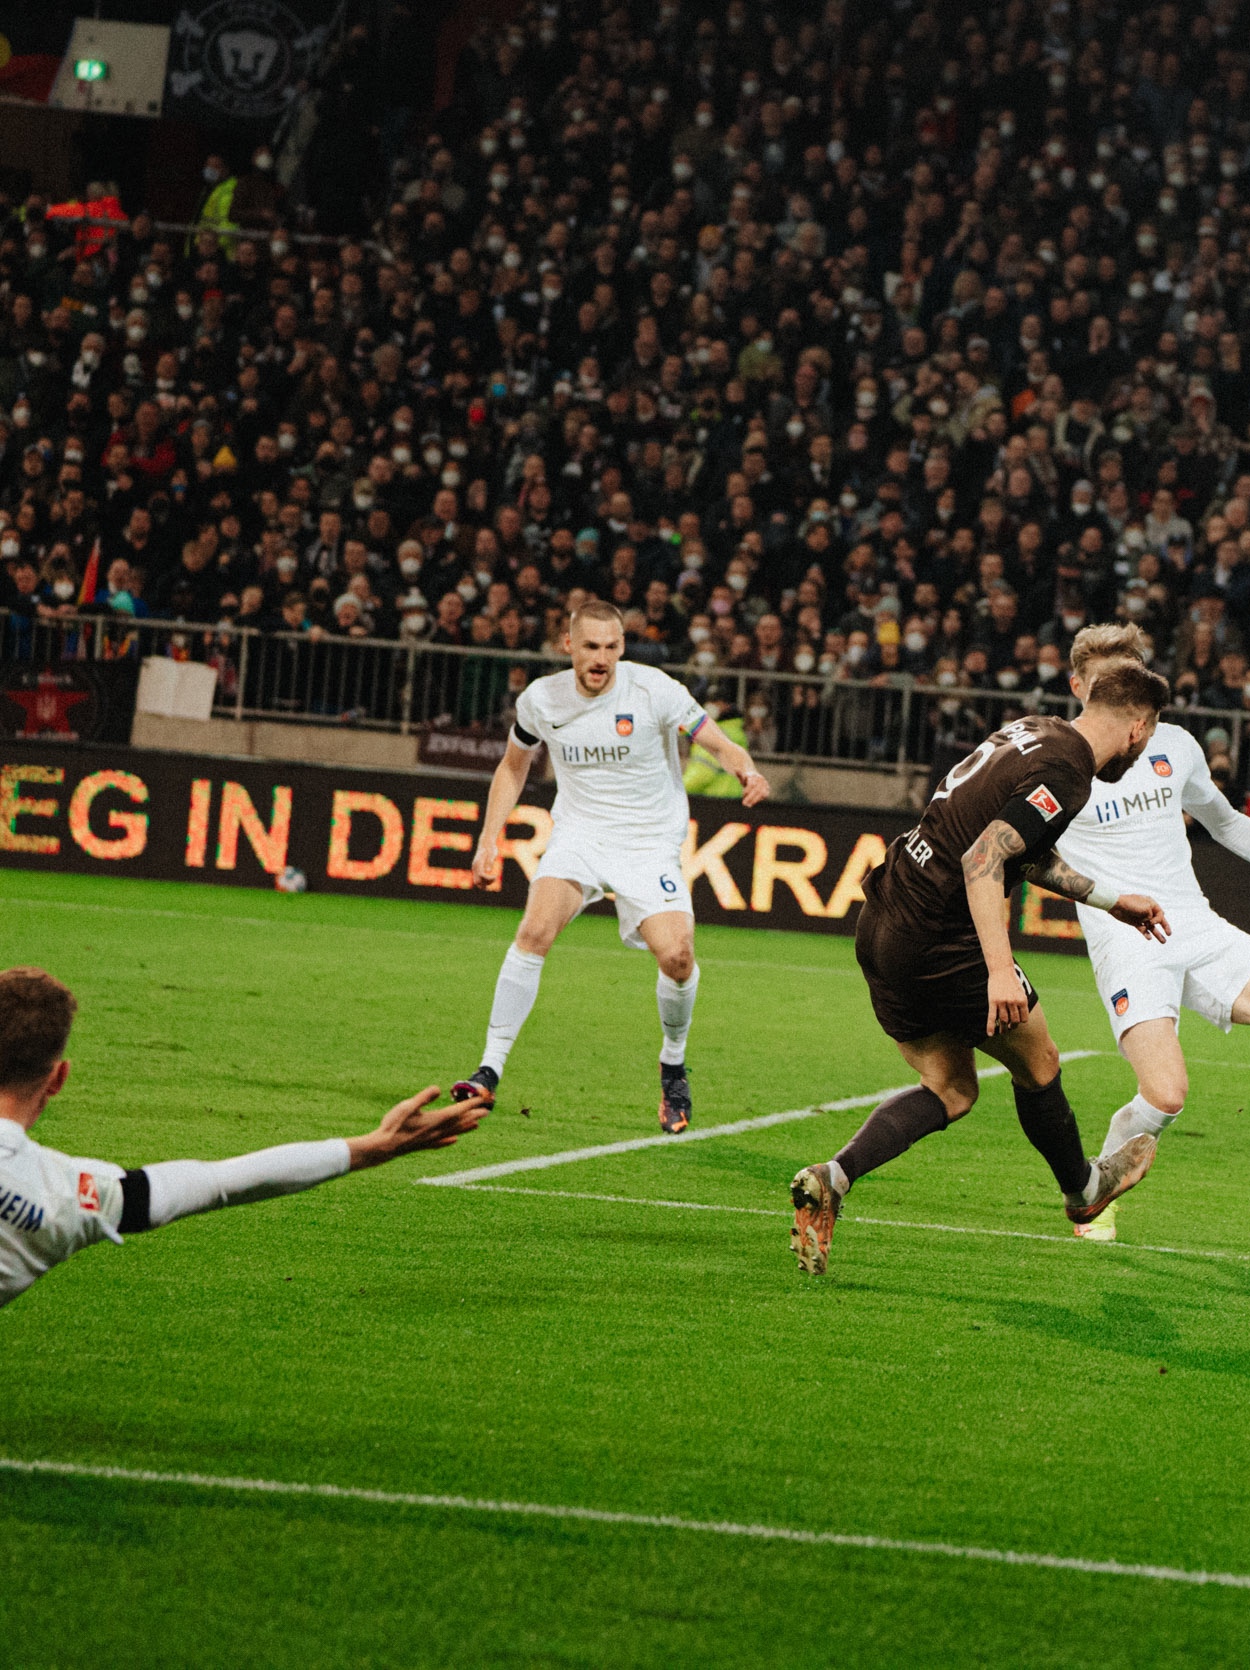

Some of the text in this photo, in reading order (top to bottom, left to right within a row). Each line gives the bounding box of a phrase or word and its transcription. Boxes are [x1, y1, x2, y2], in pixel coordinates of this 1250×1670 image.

[584, 745, 630, 762] MHP
[1122, 787, 1173, 815] MHP
[0, 764, 149, 860] EG
[185, 777, 293, 874] IN
[327, 789, 554, 893] DER
[659, 873, 677, 893] 6
